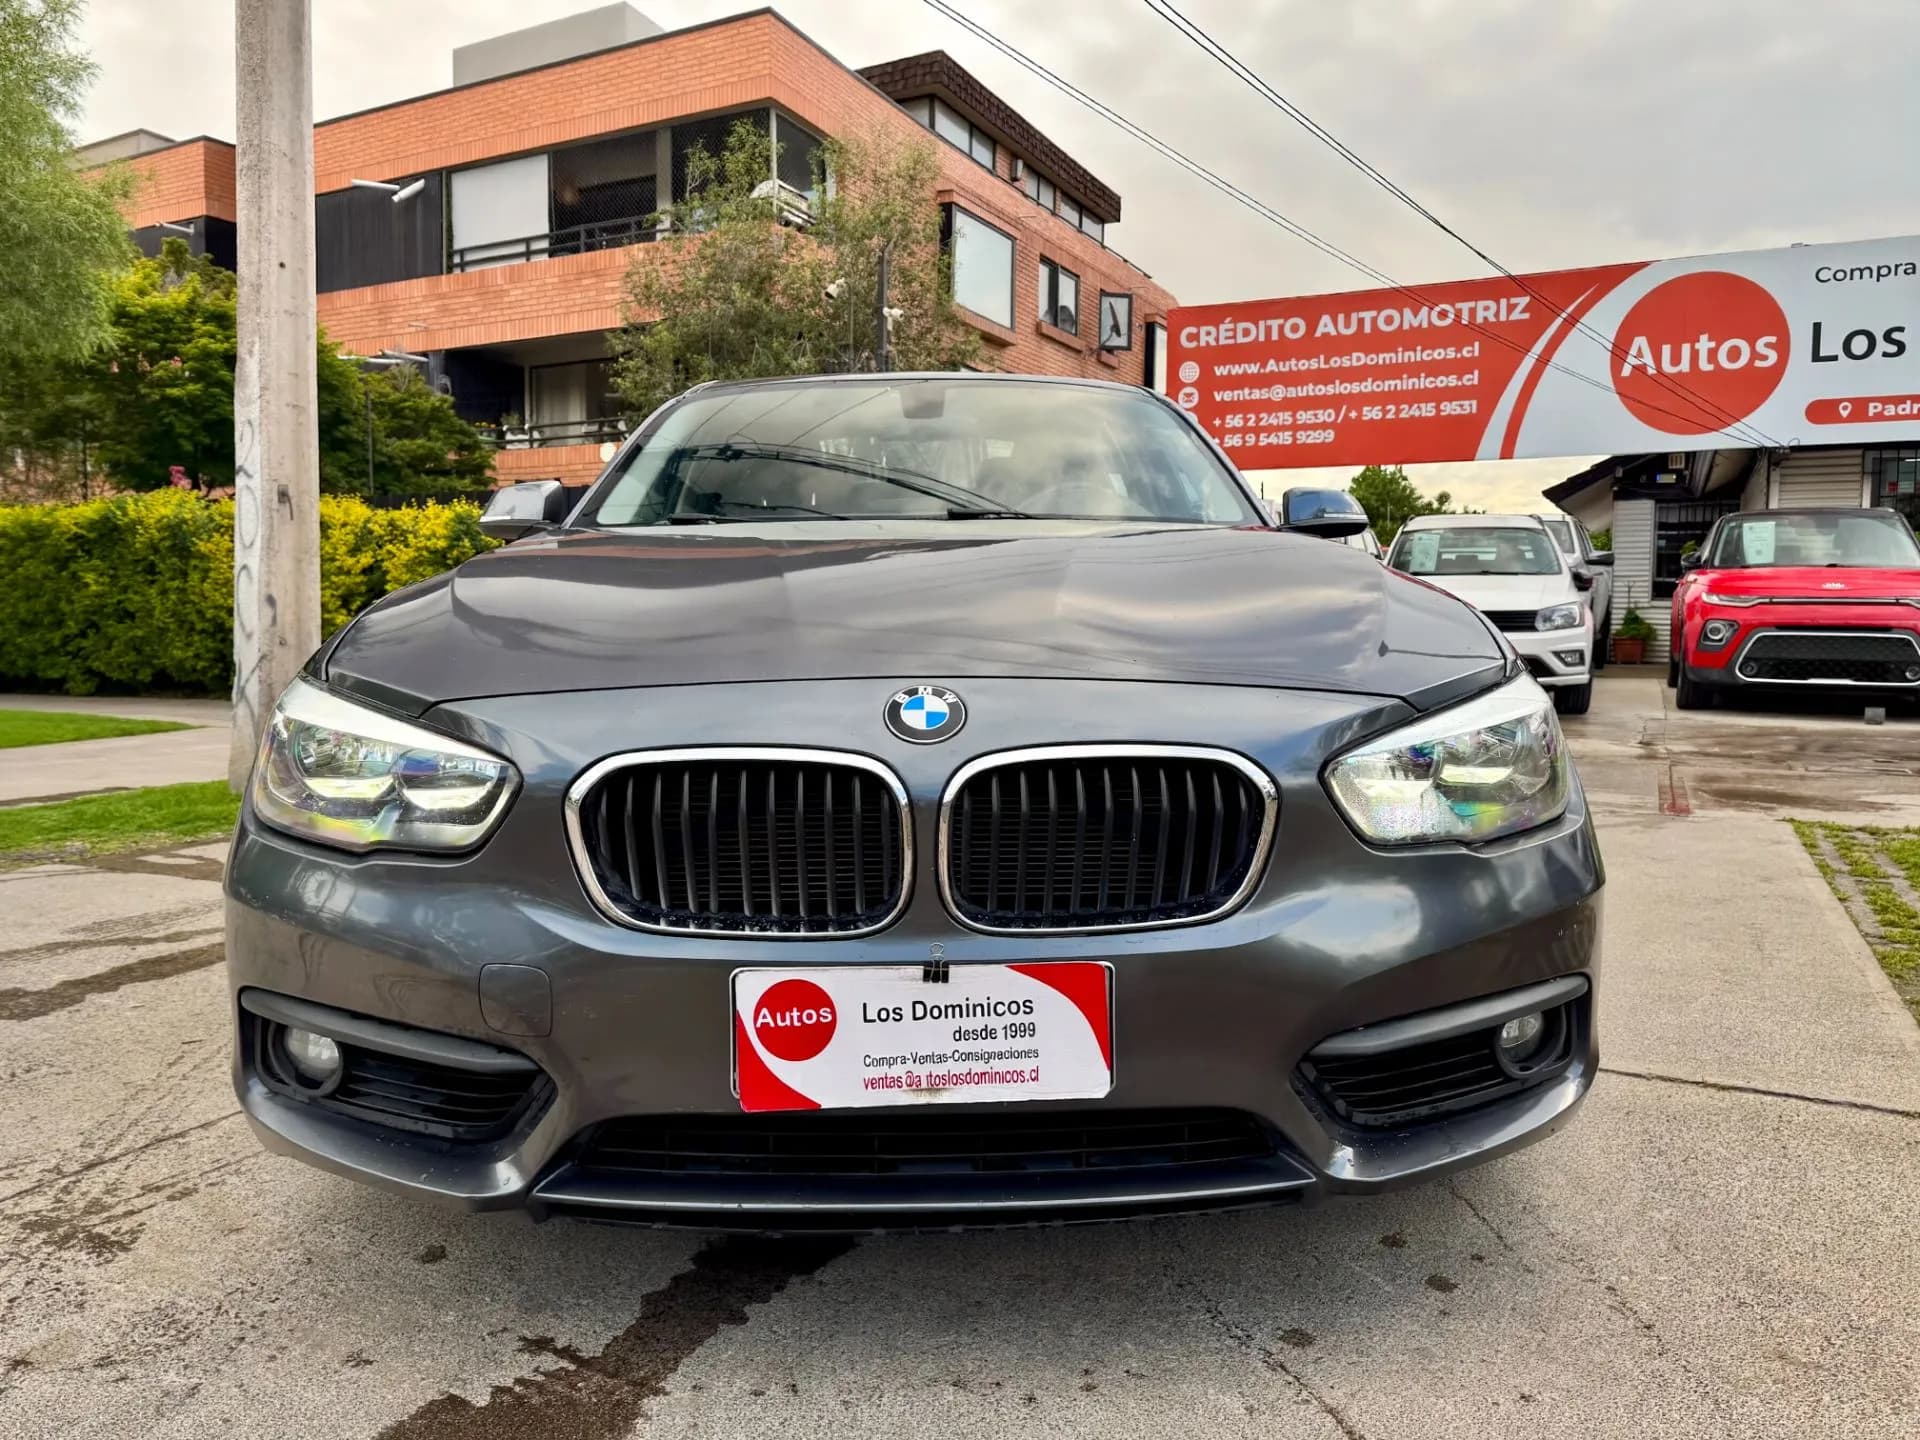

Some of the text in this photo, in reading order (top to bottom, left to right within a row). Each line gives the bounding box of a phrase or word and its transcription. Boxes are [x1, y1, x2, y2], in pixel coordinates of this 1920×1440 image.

[1815, 262, 1917, 283] Compra
[1179, 296, 1531, 349] CRÉDITO AUTOMOTRIZ
[1620, 332, 1778, 377] Autos
[1811, 321, 1907, 363] Los
[1213, 342, 1480, 377] www.AutosLosDominicos.cl
[1213, 370, 1480, 403] ventas@autoslosdominicos.cl
[1225, 414, 1244, 429] 56
[1246, 413, 1256, 427] 2
[1258, 411, 1293, 427] 2415
[1296, 408, 1336, 425] 9530
[1362, 406, 1382, 420] 56
[1385, 404, 1396, 419] 2
[1399, 402, 1436, 419] 2415
[1440, 399, 1478, 416] 9531
[1224, 433, 1243, 448] 56
[1245, 433, 1256, 446] 9
[1258, 431, 1293, 446] 5415
[1296, 429, 1336, 445] 9299
[894, 686, 958, 704] BMW
[755, 1004, 833, 1029] Autos
[862, 996, 1034, 1024] Los Dominicos
[952, 1022, 1036, 1042] desde 1999
[863, 1046, 1039, 1069] Compra-Ventas-Consignaciones
